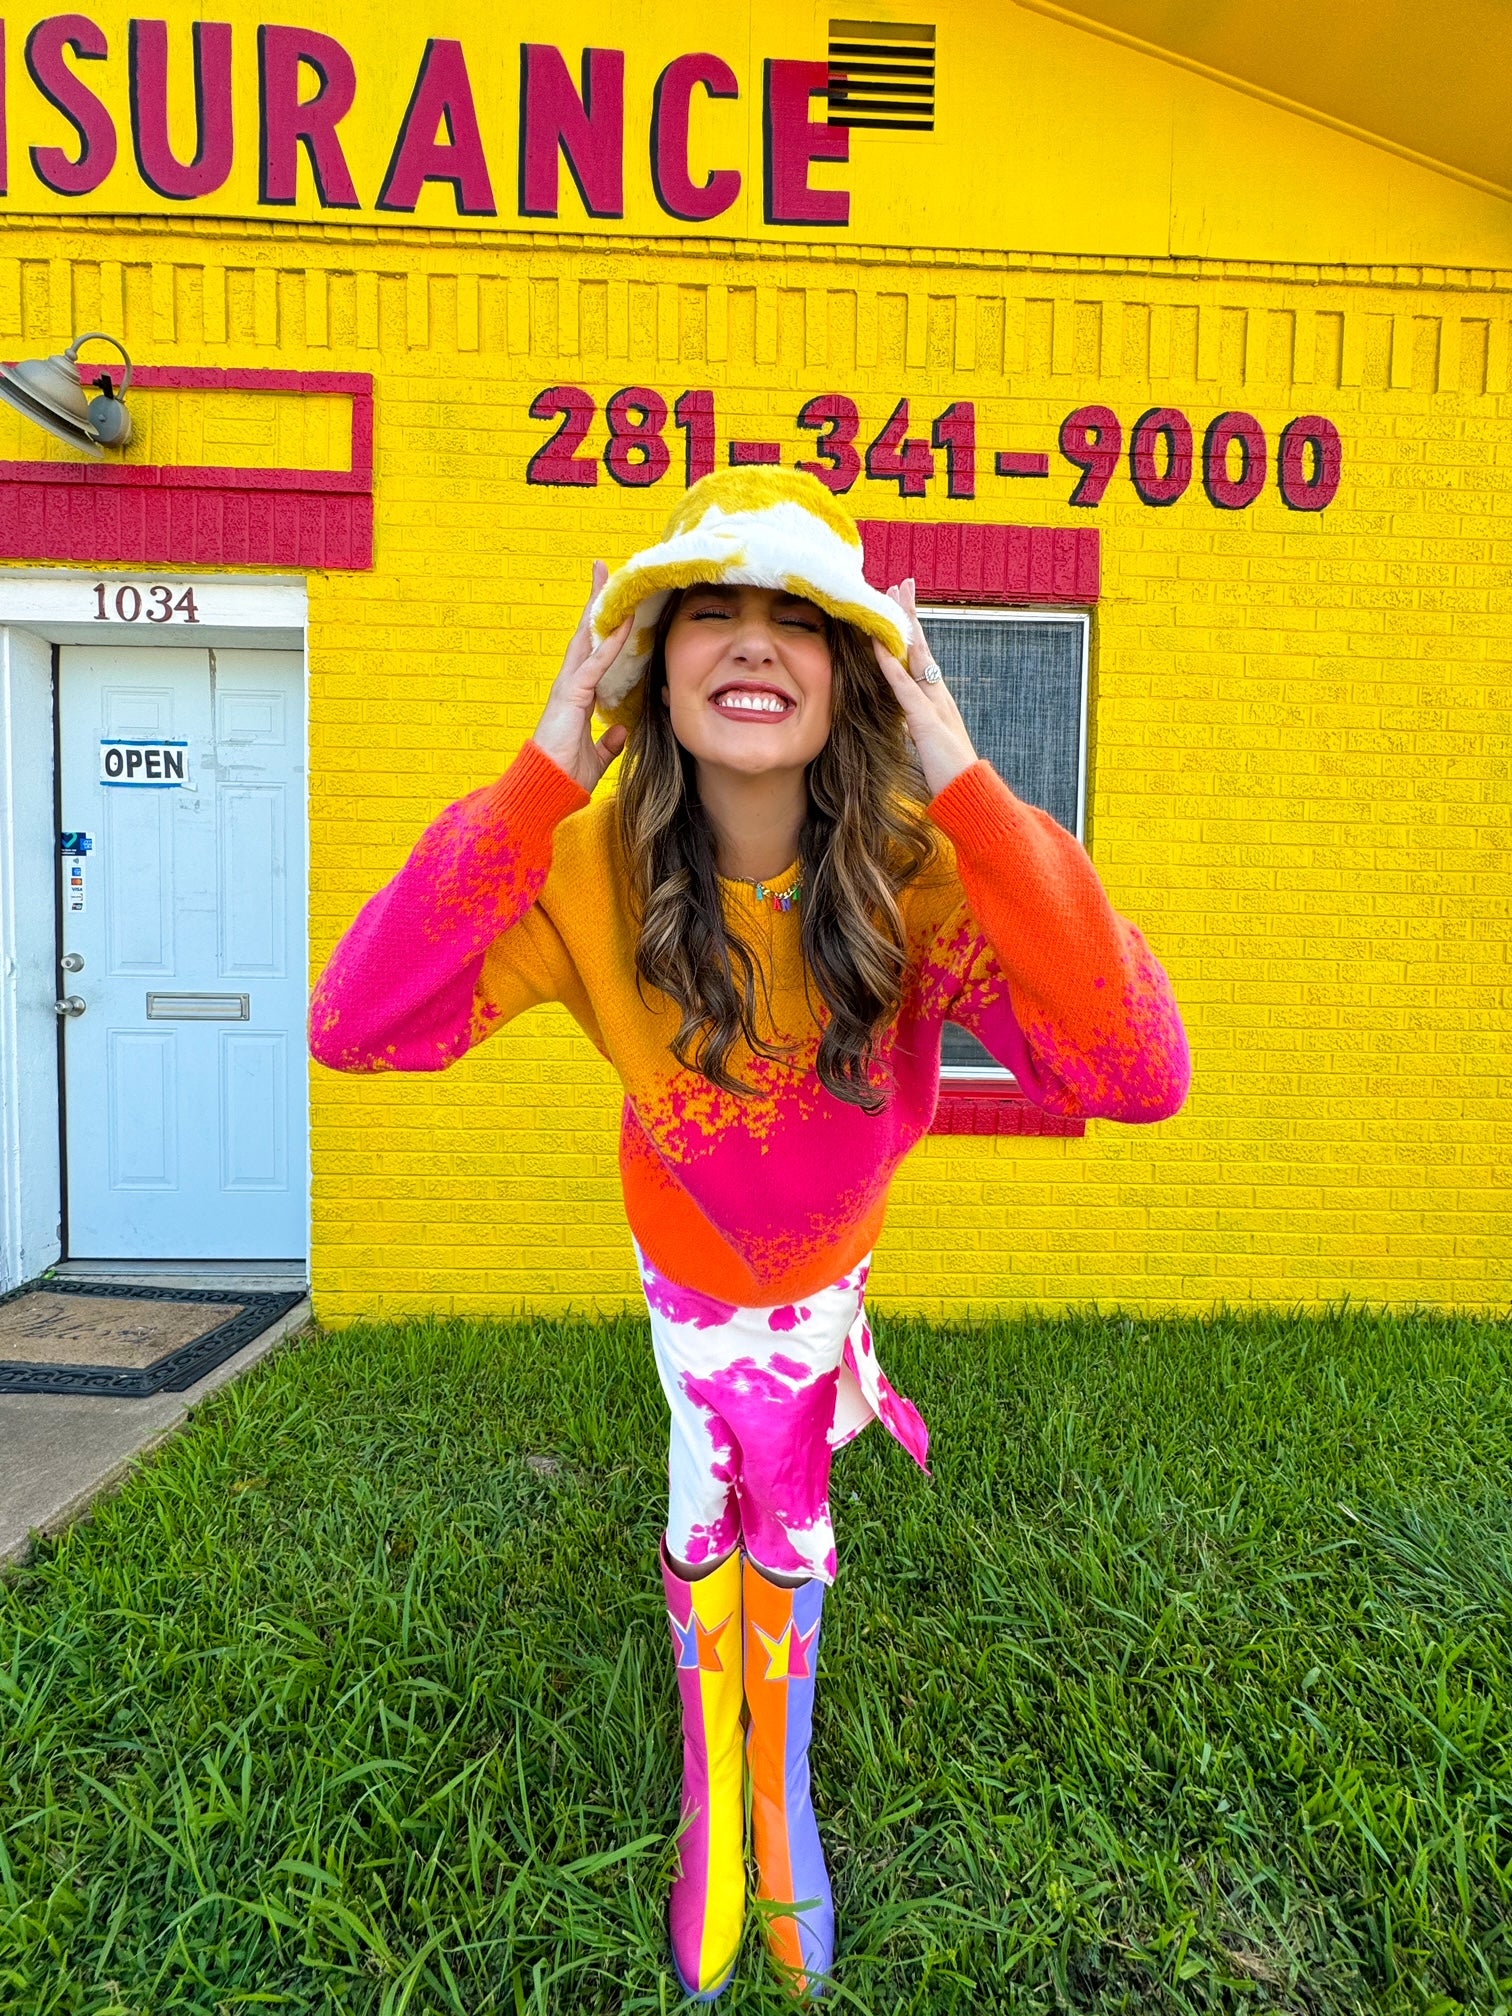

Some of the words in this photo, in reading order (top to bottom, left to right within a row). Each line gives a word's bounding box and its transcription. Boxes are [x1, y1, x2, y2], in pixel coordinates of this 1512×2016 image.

[0, 14, 850, 226] SURANCE
[526, 386, 1342, 512] 281-341-9000
[93, 583, 200, 623] 1034
[104, 748, 184, 779] OPEN
